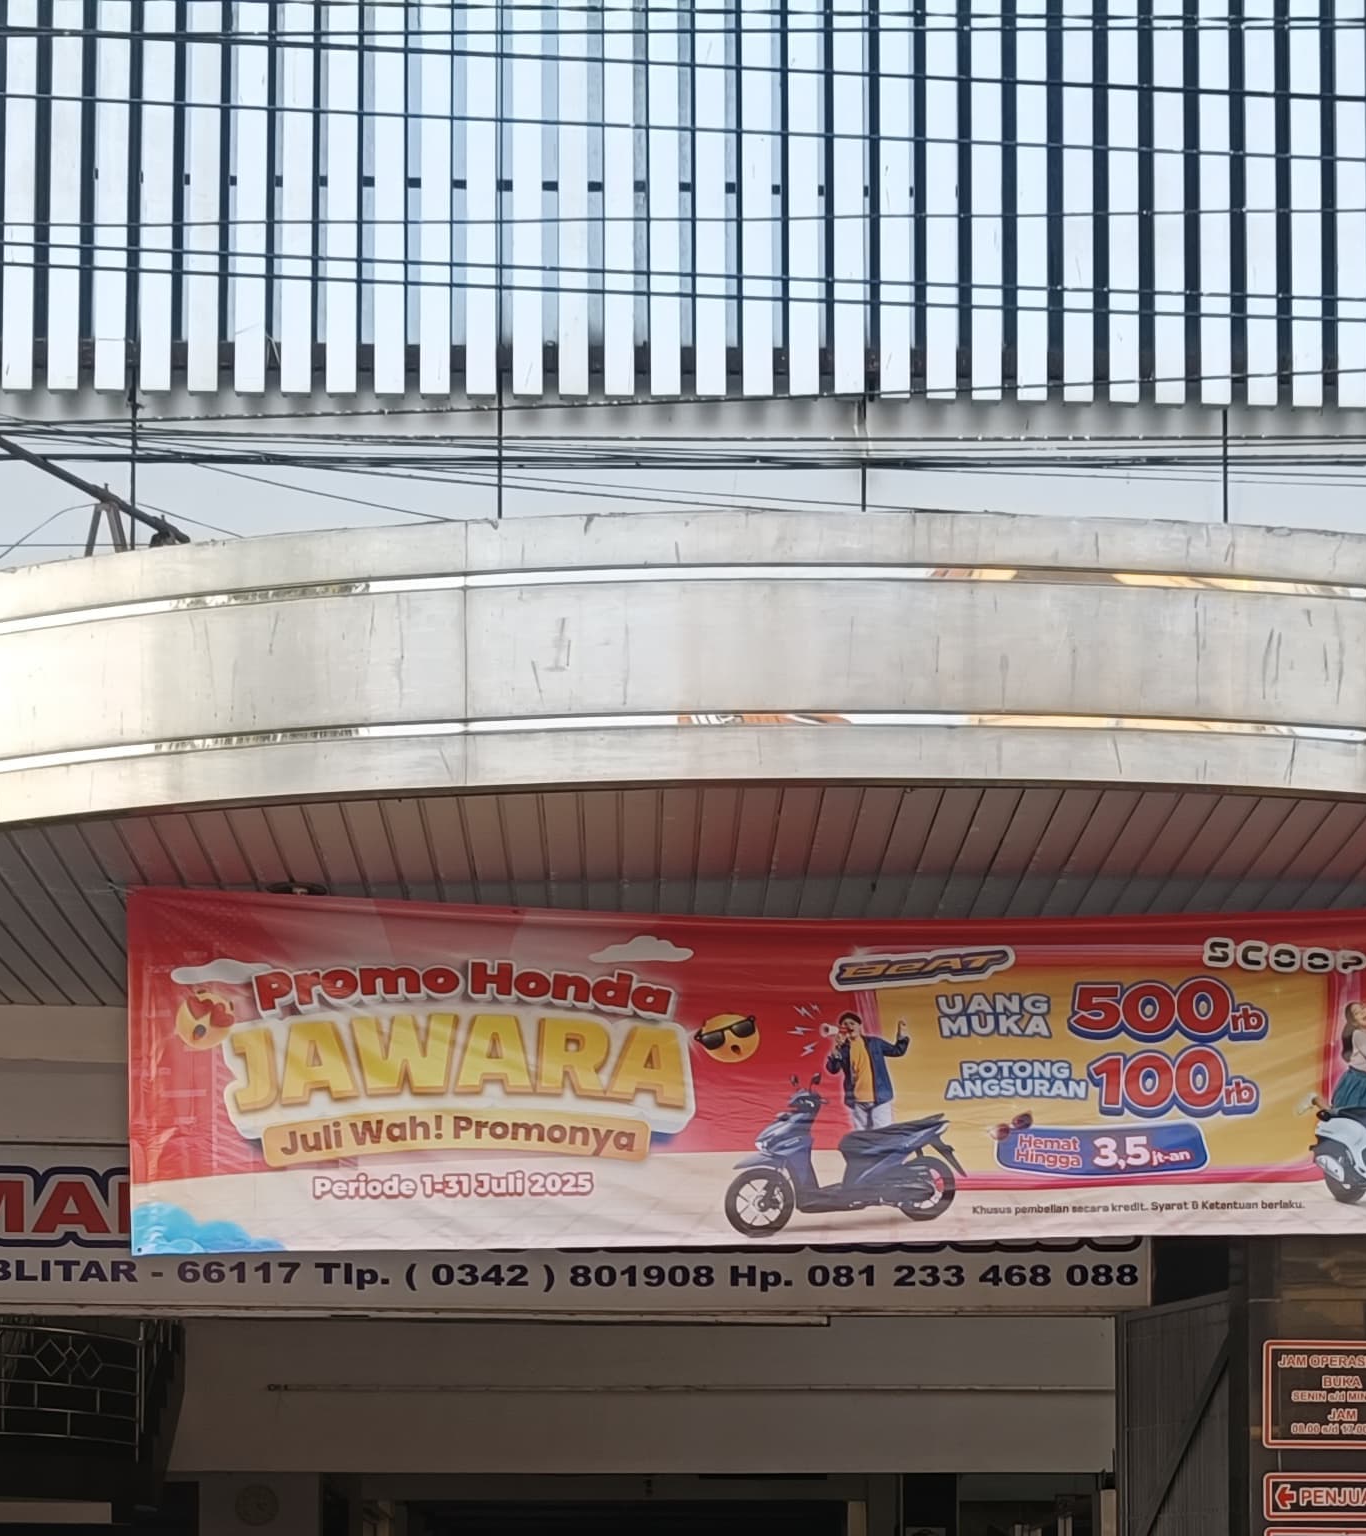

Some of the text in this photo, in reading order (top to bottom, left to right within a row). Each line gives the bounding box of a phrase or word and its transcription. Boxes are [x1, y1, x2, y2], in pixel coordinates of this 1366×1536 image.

[254, 959, 673, 1016] Promo Honda
[936, 993, 1051, 1015] UANG
[938, 1013, 1052, 1038] MUKA
[234, 1011, 692, 1112] JAWARA
[960, 1060, 1071, 1080] POTONG
[945, 1078, 1088, 1100] ANGSURAN
[280, 1113, 637, 1158] Juli Wah! Promonya
[1018, 1134, 1081, 1152] Hemat
[1015, 1149, 1082, 1169] Hingga
[312, 1171, 594, 1200] Periode 1-31 Juli 2025
[971, 1204, 1012, 1216] Khusus
[1014, 1204, 1070, 1217] pembelian
[1072, 1204, 1109, 1214] secara
[1150, 1201, 1190, 1212] Syarat
[1201, 1200, 1259, 1211] Ketentuan
[176, 1260, 302, 1286] 66117
[314, 1261, 390, 1290] Tlp.
[430, 1263, 530, 1288] 0342
[568, 1264, 715, 1289] 801908
[728, 1264, 794, 1292] Hp.
[806, 1264, 877, 1289] 081
[892, 1264, 966, 1289] 233
[978, 1263, 1052, 1287] 468
[1065, 1263, 1139, 1287] 088
[1277, 1354, 1308, 1369] JAM
[1321, 1374, 1363, 1389] BUKA
[1291, 1389, 1328, 1402] SENIN
[1327, 1408, 1358, 1421] JAM
